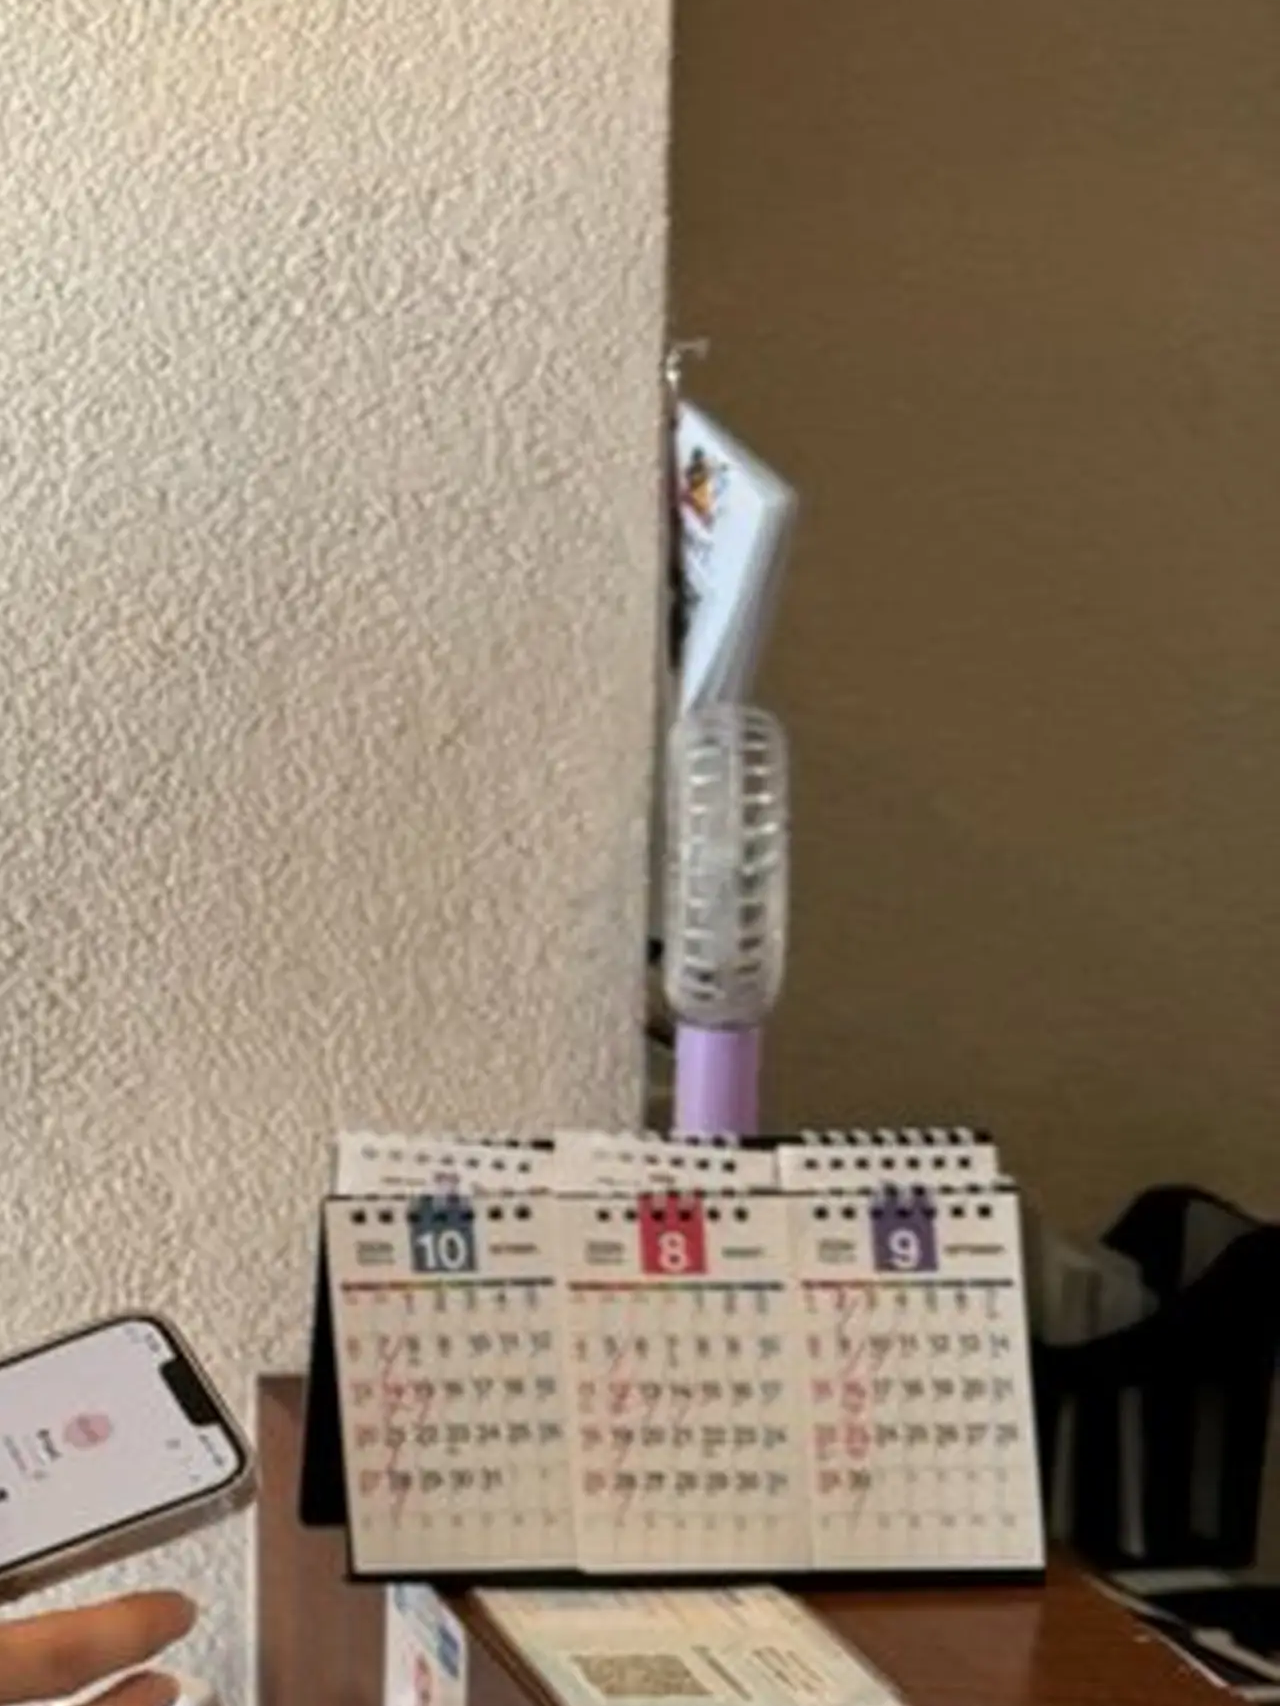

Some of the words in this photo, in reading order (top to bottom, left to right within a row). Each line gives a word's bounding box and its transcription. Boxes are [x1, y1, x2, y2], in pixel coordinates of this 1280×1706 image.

[416, 1230, 467, 1270] 10
[658, 1231, 689, 1272] 8
[888, 1228, 923, 1270] 9
